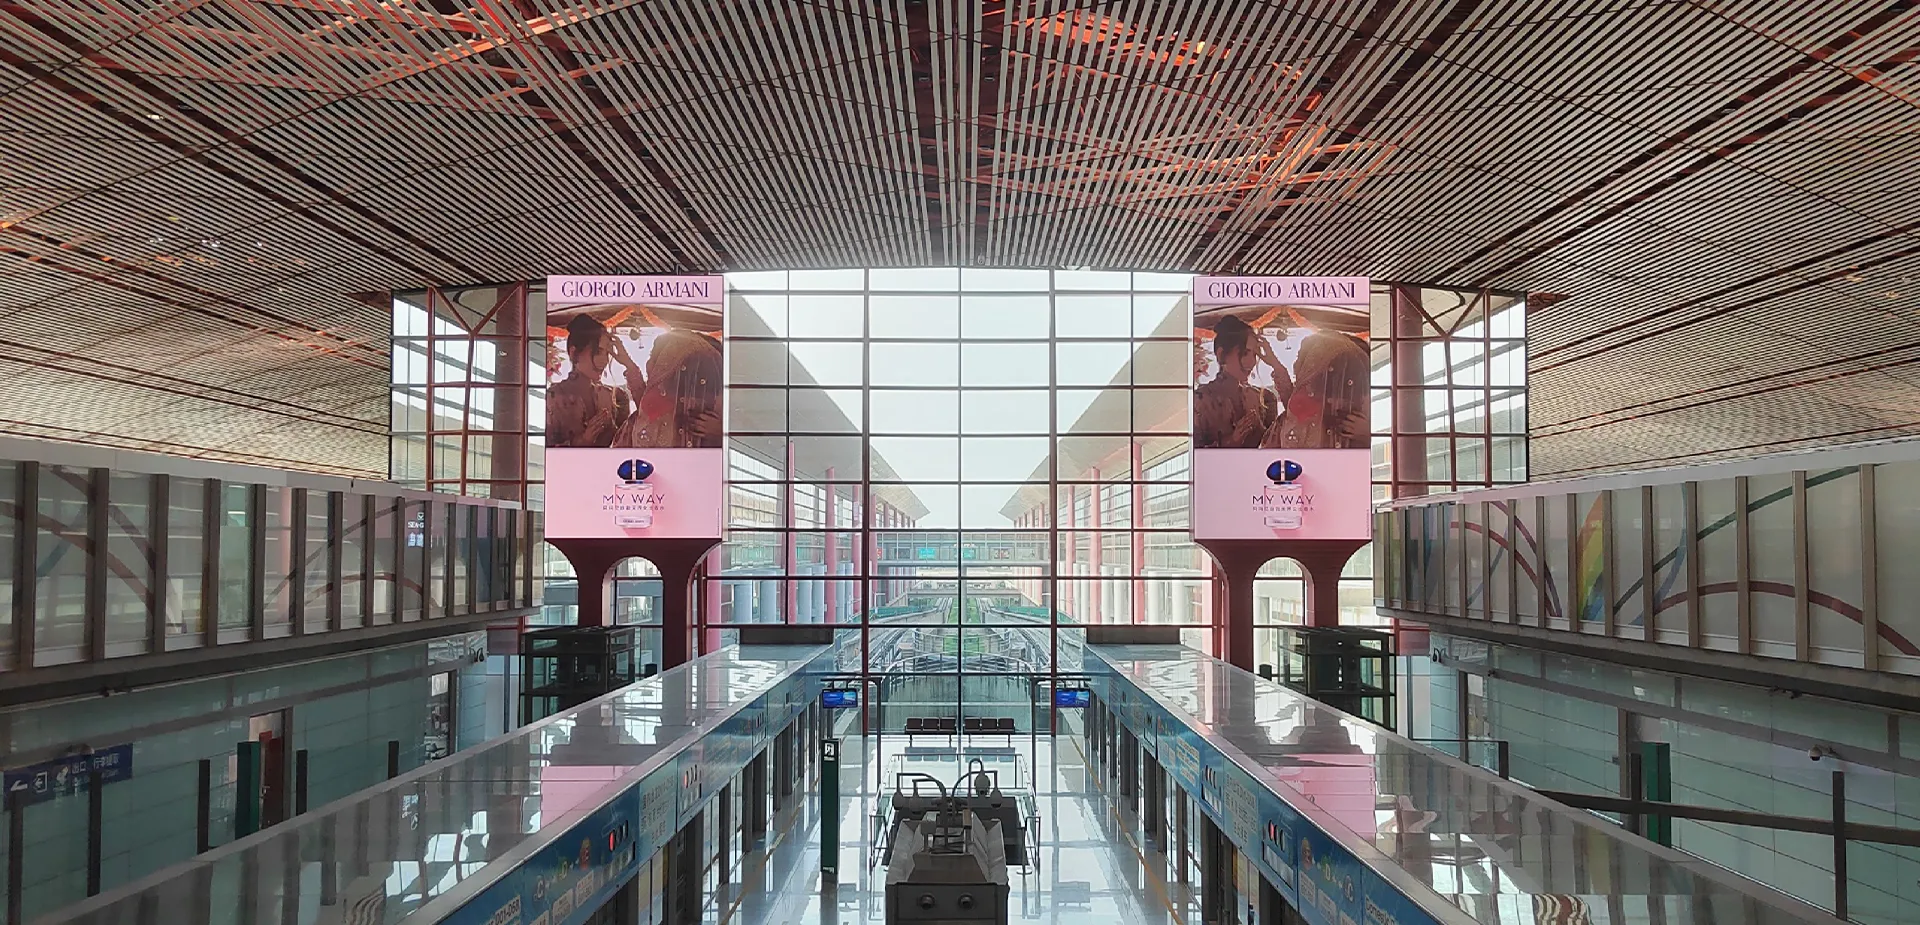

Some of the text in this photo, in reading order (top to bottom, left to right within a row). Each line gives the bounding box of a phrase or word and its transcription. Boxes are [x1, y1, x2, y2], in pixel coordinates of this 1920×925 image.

[561, 280, 709, 298] GIORGIO ARMANI
[1208, 281, 1356, 299] GIORGIO ARMANI
[602, 494, 665, 504] MY WAY
[1252, 494, 1315, 505] MY WAY
